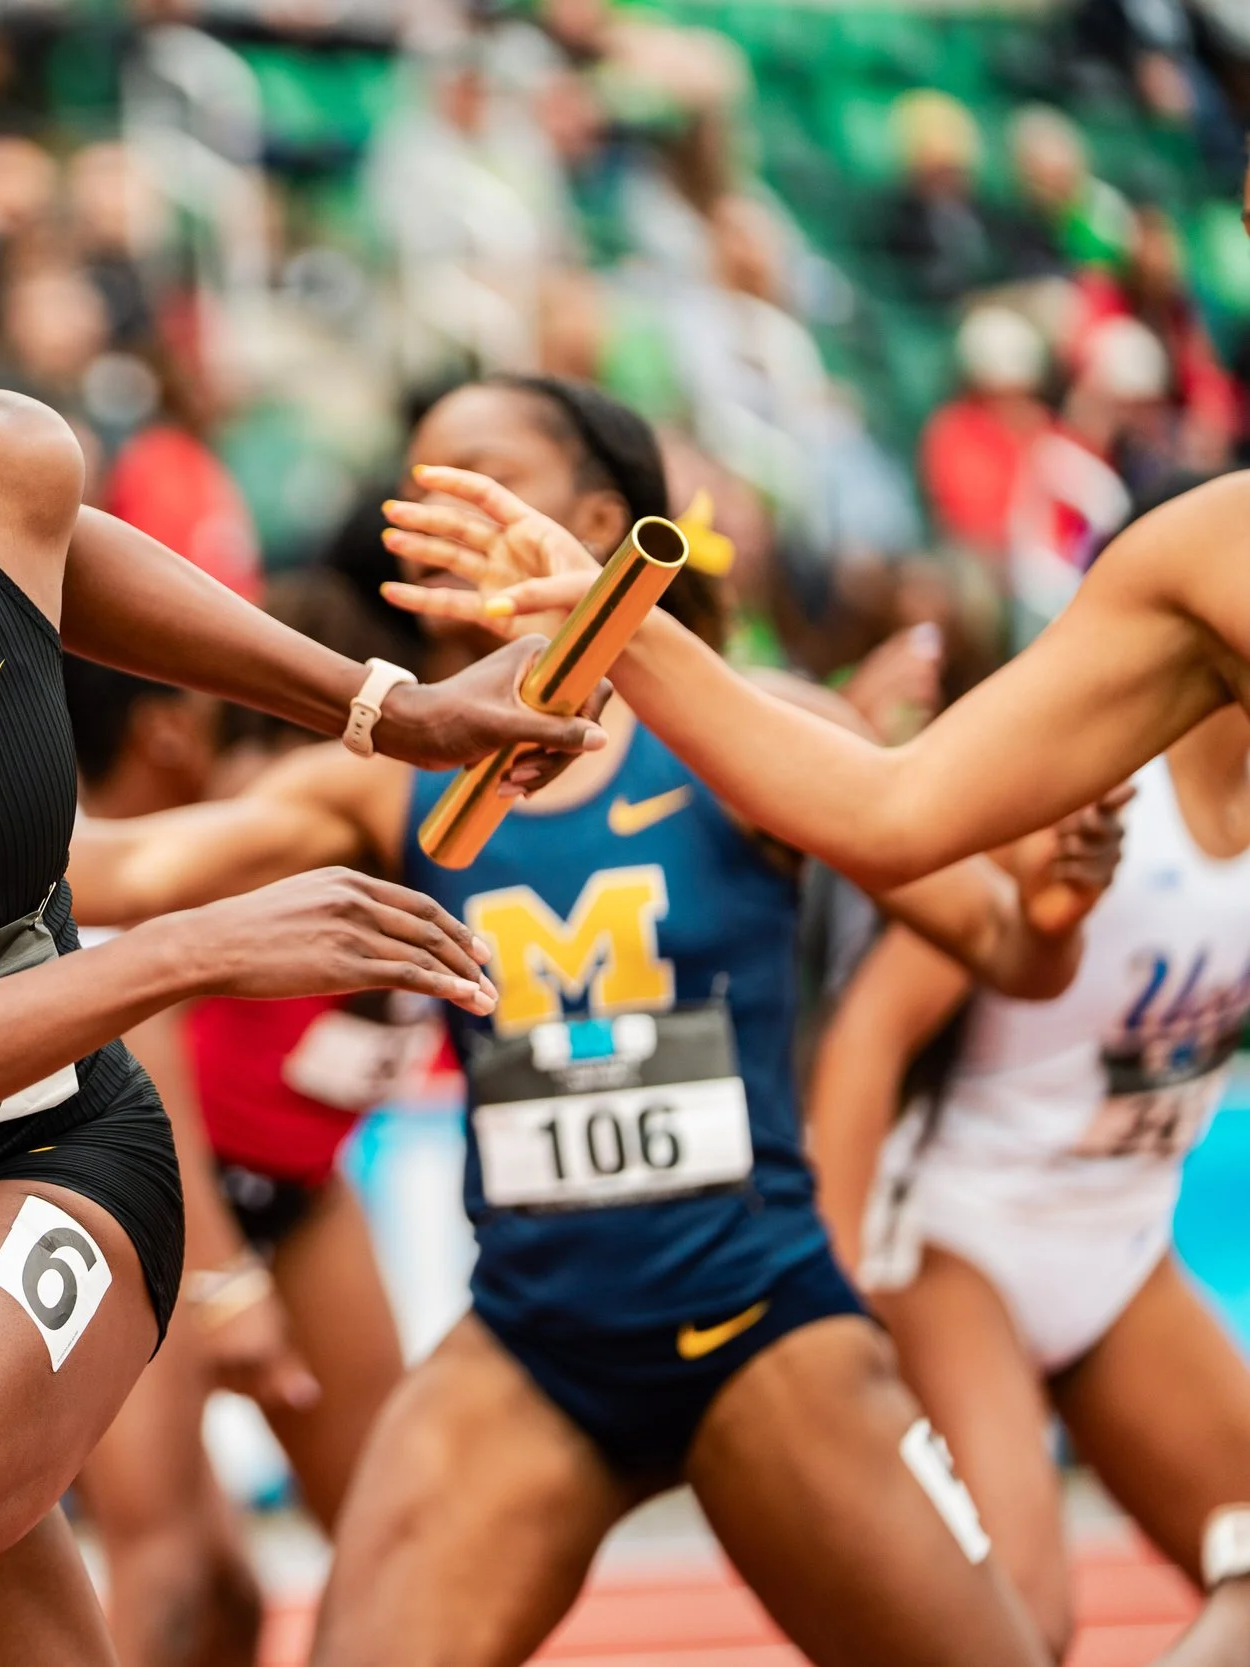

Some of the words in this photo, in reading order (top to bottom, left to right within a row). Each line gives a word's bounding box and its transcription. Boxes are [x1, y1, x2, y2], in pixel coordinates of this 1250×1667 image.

[463, 863, 676, 1038] M
[538, 1105, 681, 1181] 106
[21, 1226, 98, 1332] 6
